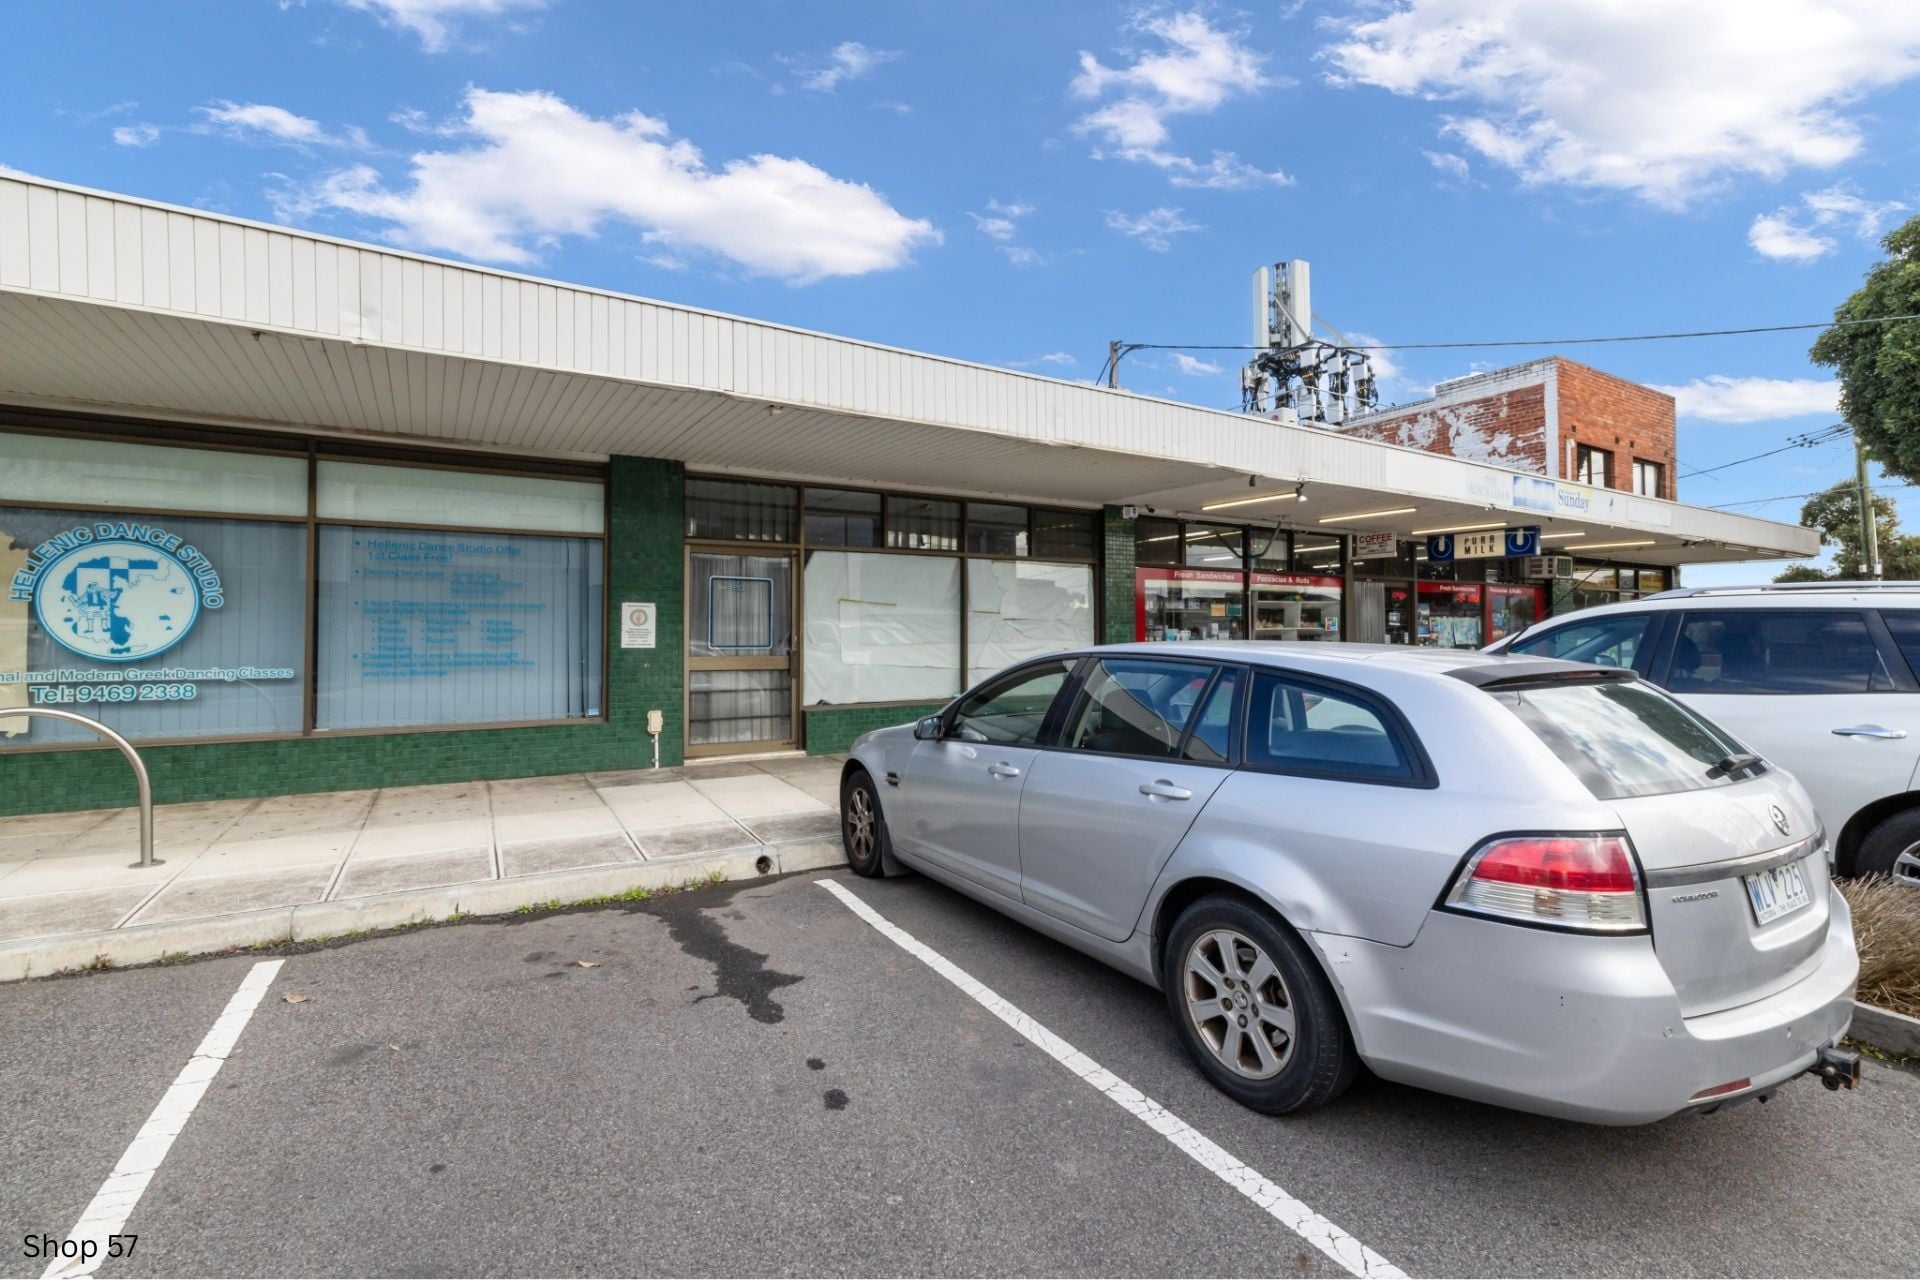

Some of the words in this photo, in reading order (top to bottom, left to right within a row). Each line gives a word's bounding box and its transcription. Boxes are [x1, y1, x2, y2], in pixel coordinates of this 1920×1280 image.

[1557, 488, 1590, 512] Sunday
[1359, 532, 1393, 544] COFFEE
[367, 539, 416, 550] Hellenic
[419, 541, 455, 552] Dance
[458, 543, 493, 554] Studio
[1464, 544, 1495, 554] MILK
[368, 551, 385, 560] 1st
[388, 551, 420, 561] Class
[8, 526, 92, 601] HELLENIC
[95, 523, 183, 551] DANCE
[177, 544, 224, 609] STUDIO
[1174, 570, 1194, 579] Fresh
[1196, 571, 1236, 581] Sandwiches
[1296, 576, 1311, 584] Rolls
[24, 670, 55, 681] and
[60, 669, 122, 681] Modern
[125, 668, 172, 682] Greek
[174, 668, 235, 681] Dancing
[238, 667, 294, 679] Classes
[30, 685, 74, 703] Tel:
[77, 685, 136, 702] 9469
[140, 684, 196, 701] 2338
